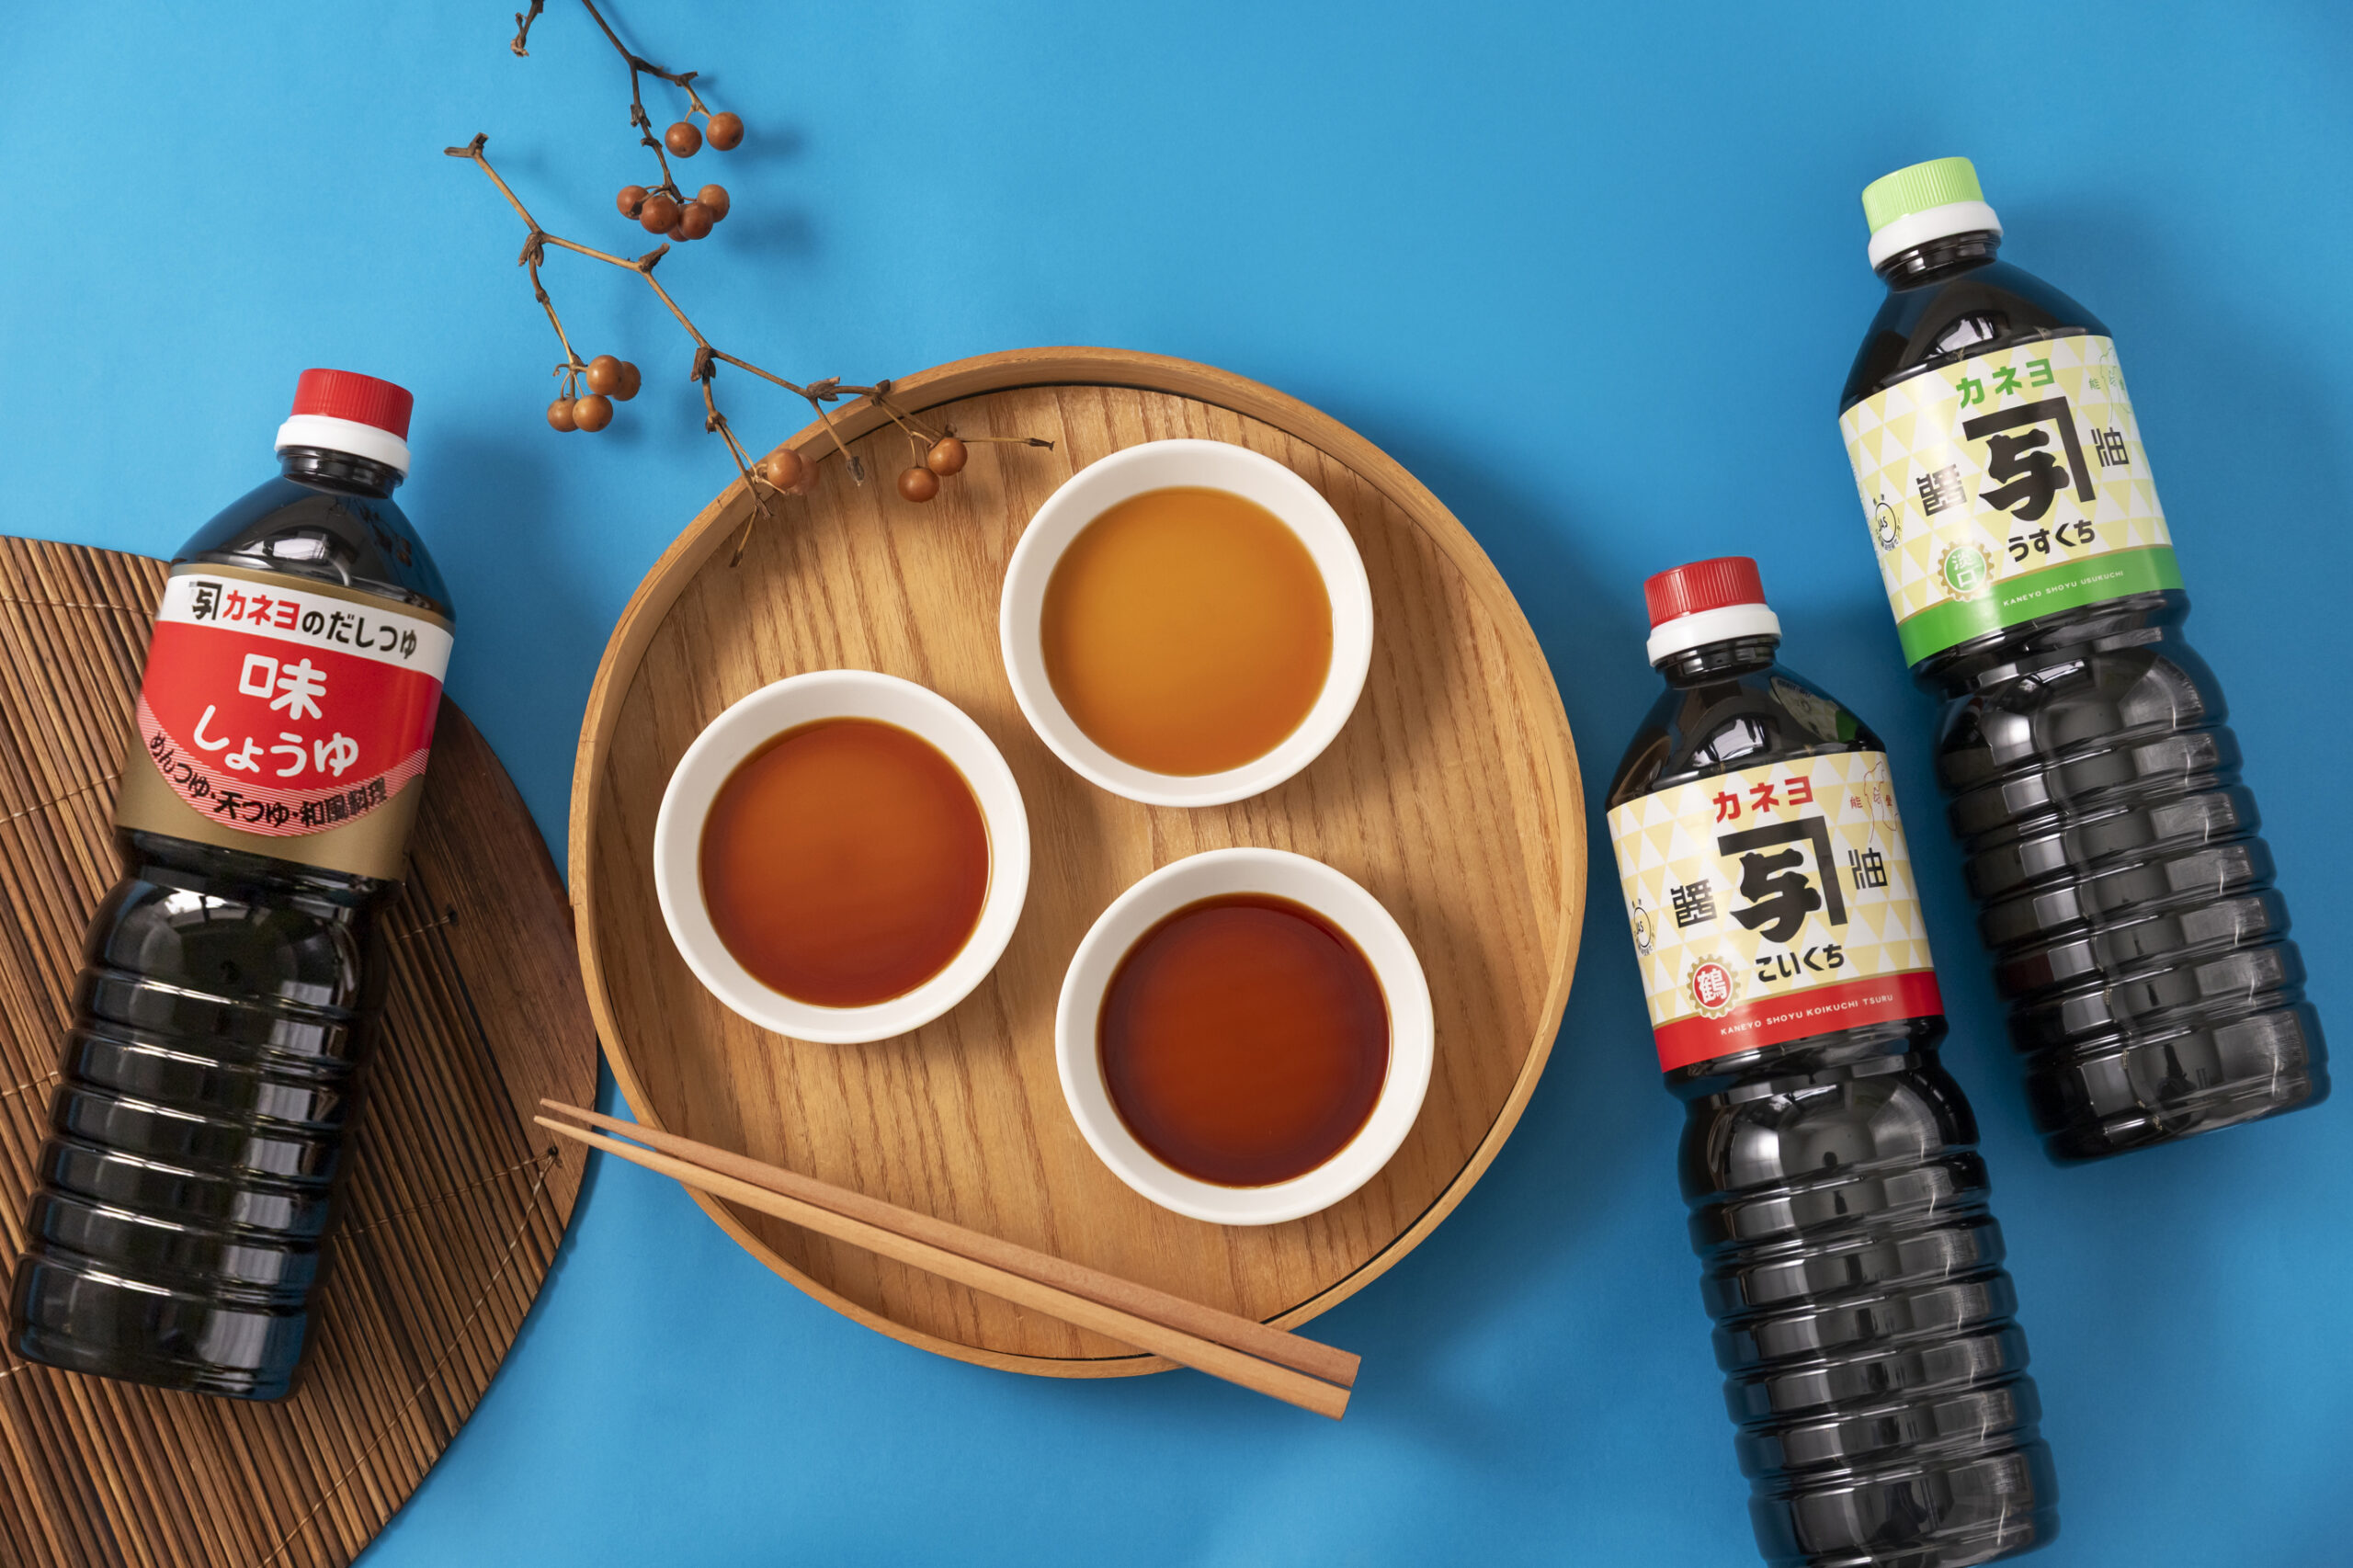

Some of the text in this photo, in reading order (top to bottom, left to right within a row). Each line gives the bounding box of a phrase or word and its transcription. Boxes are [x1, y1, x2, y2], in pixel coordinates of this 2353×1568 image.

[1956, 358, 2055, 409] カネヨ
[2091, 426, 2130, 467] 油
[2008, 519, 2096, 562] うすくち
[2003, 570, 2124, 607] KANEYO SHOYU USUKUCHI
[222, 589, 418, 659] カネヨのだしつゆ
[239, 653, 328, 721] 味
[193, 704, 359, 778] しょうゆ
[1713, 776, 1814, 824] カネヨ
[1848, 847, 1888, 891] 油
[1756, 943, 1845, 983] こいくち
[1697, 968, 1728, 1004] 鶴
[1721, 994, 1894, 1036] KANEYO SHOYU KOIKUCHI TSURU
